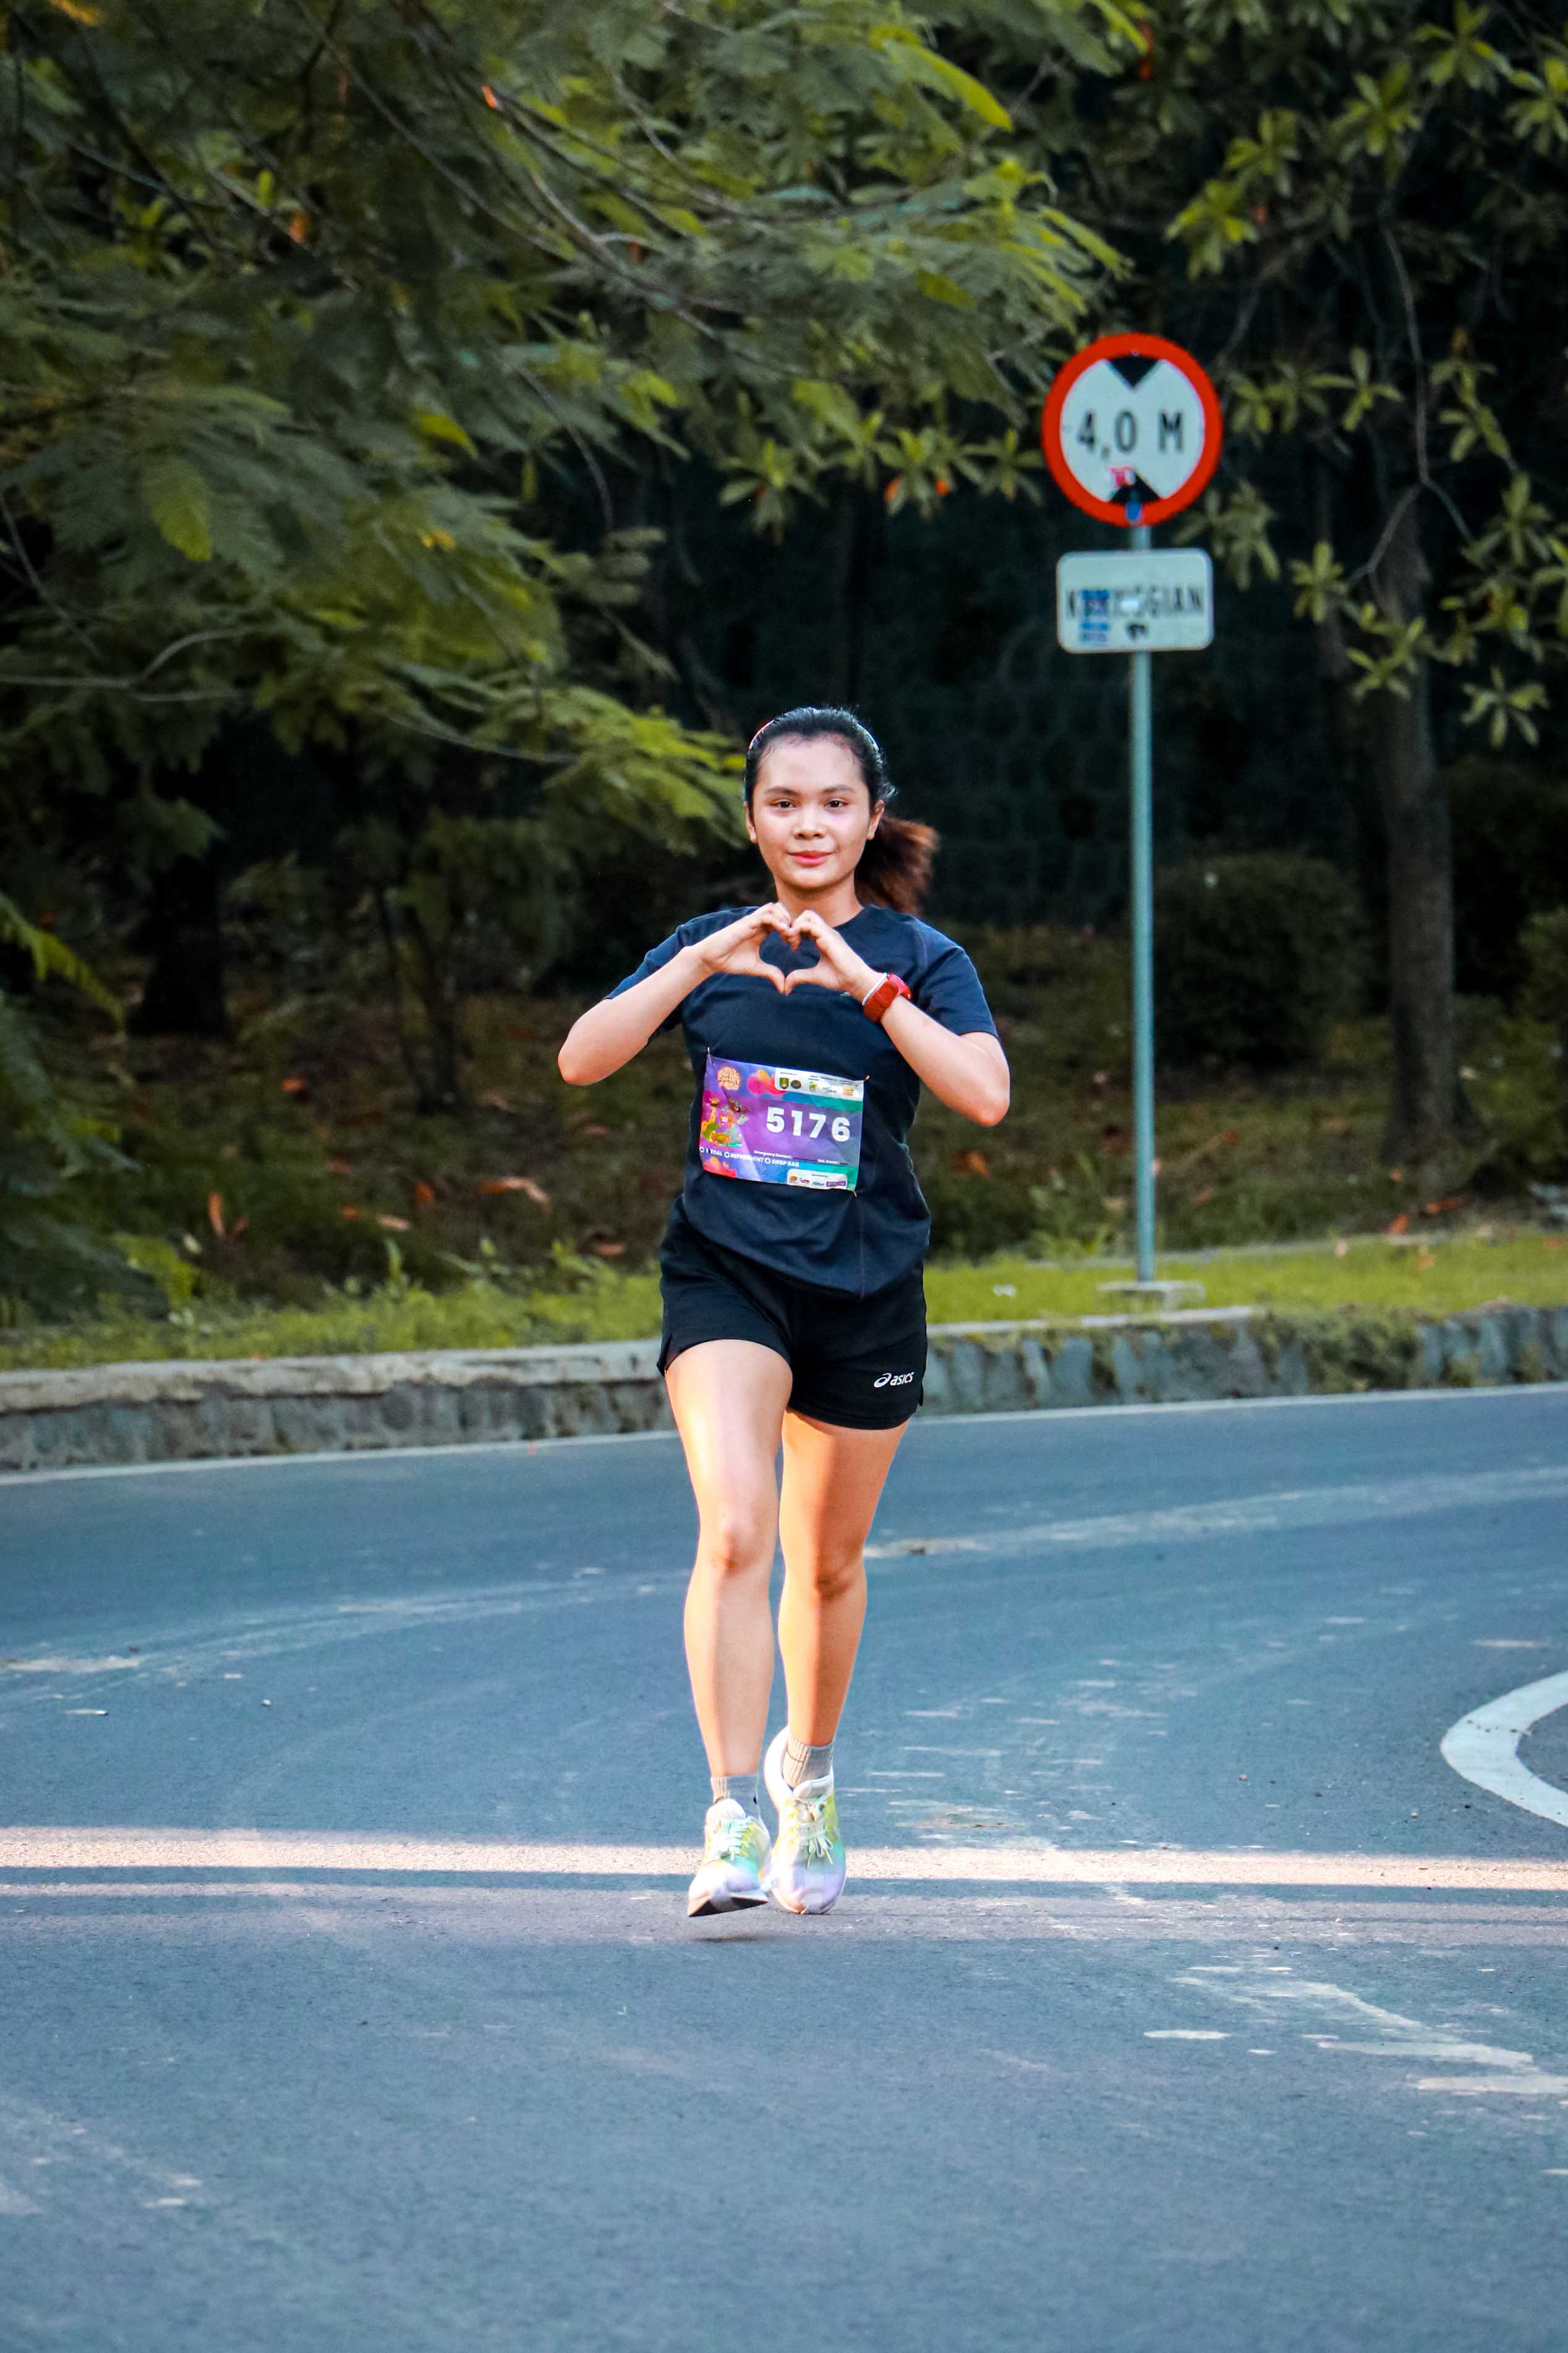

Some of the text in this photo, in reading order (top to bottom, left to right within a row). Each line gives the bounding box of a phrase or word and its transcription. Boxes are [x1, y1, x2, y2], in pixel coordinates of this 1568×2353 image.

[1158, 409, 1183, 453] M
[766, 1106, 851, 1142] 5176
[890, 1372, 914, 1386] asics
